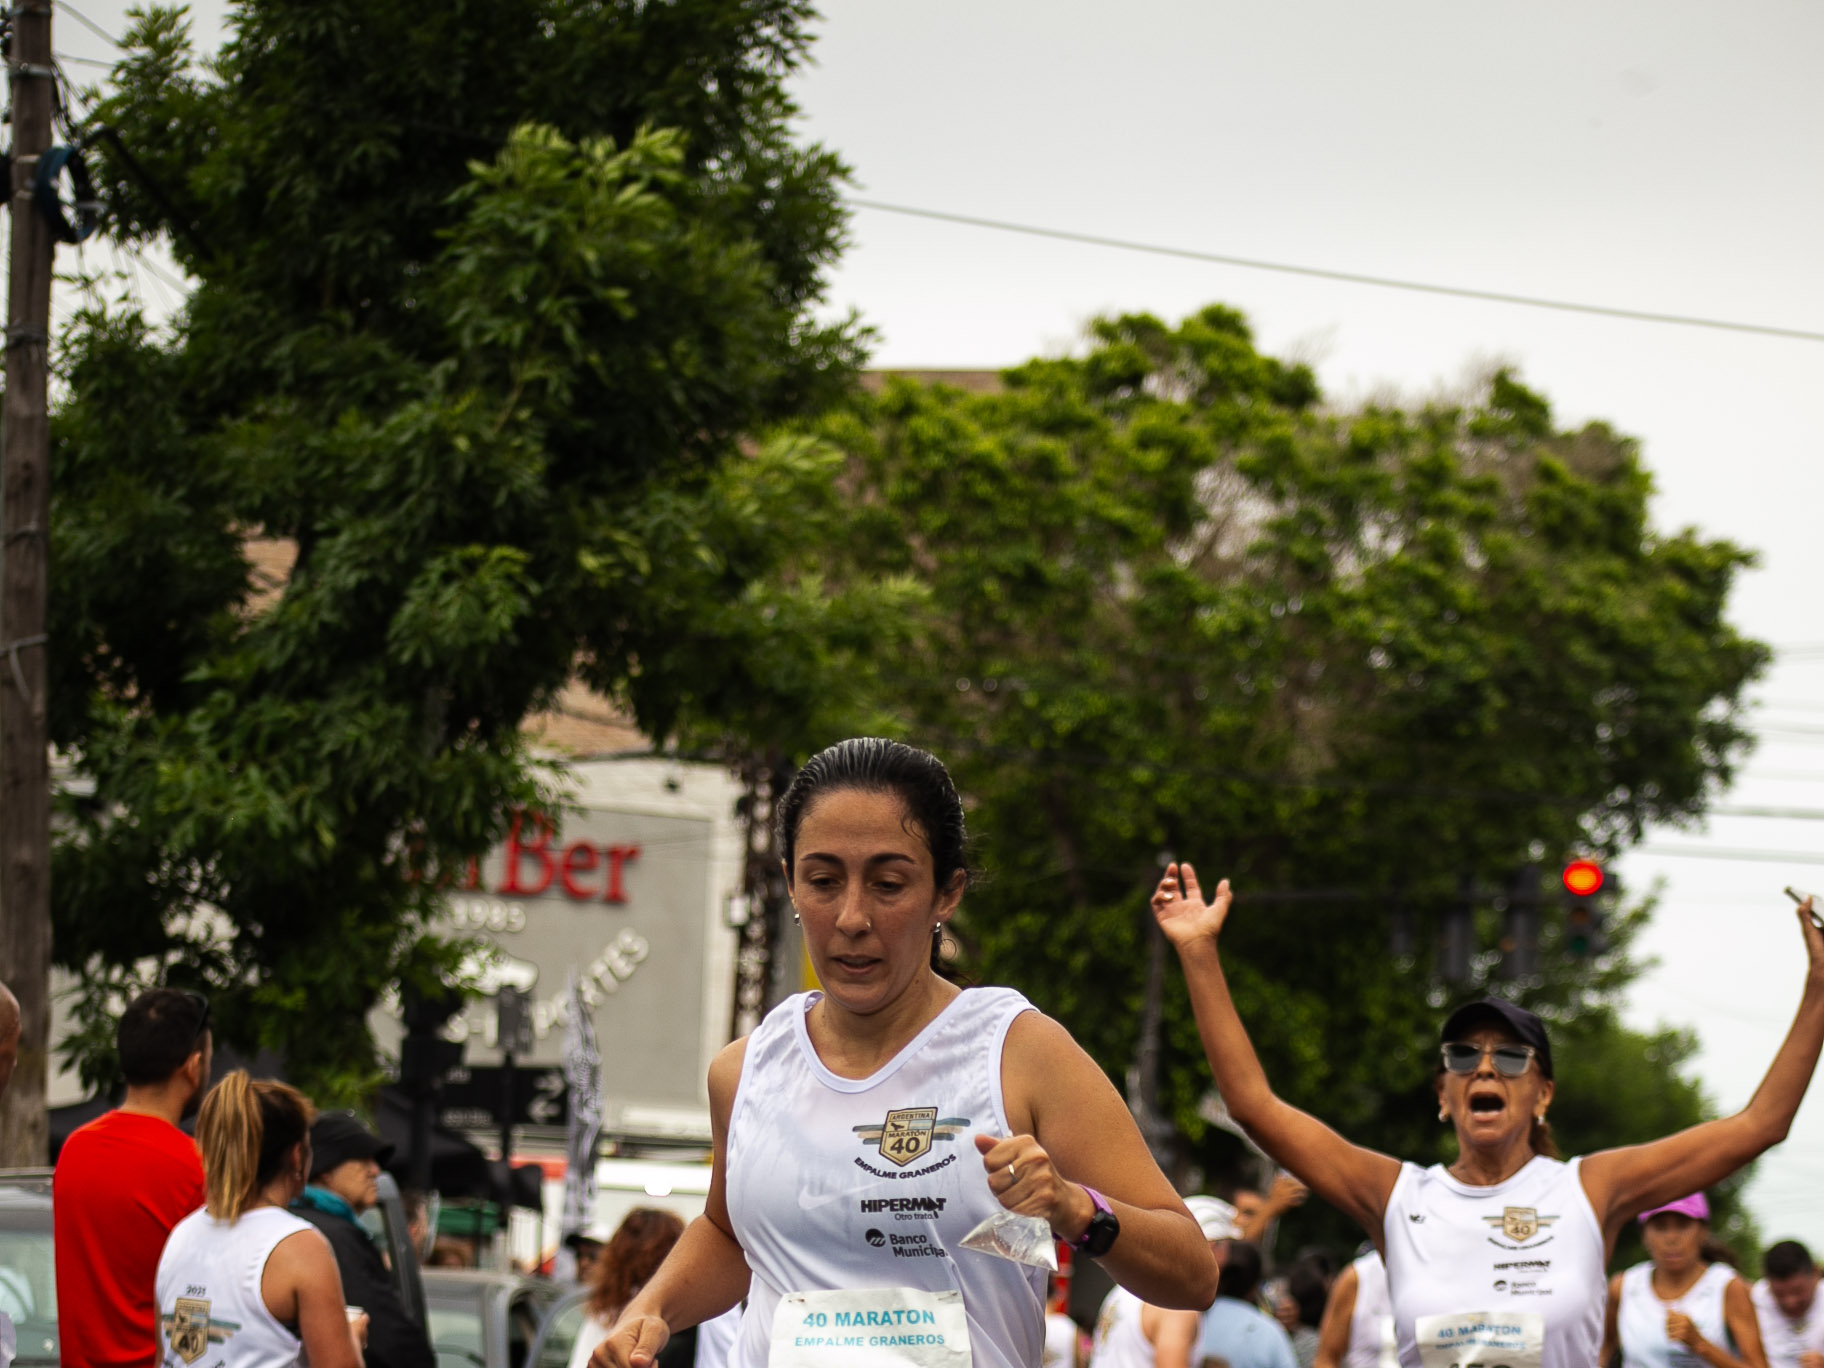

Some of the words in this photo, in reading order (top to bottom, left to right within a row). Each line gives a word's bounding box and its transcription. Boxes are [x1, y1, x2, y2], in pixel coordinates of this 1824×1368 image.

[891, 1112, 931, 1121] ARGENTINA
[889, 1137, 921, 1155] 40
[854, 1157, 897, 1179] EMPALME
[899, 1154, 957, 1179] GRANEROS
[894, 1213, 913, 1221] Otro
[889, 1234, 928, 1245] Banco
[892, 1244, 949, 1258] Municipa
[802, 1312, 828, 1328] 40
[835, 1309, 936, 1327] MARATON
[1437, 1328, 1454, 1339] 40
[795, 1336, 864, 1347] EMPALME
[869, 1334, 945, 1347] GRANEROS
